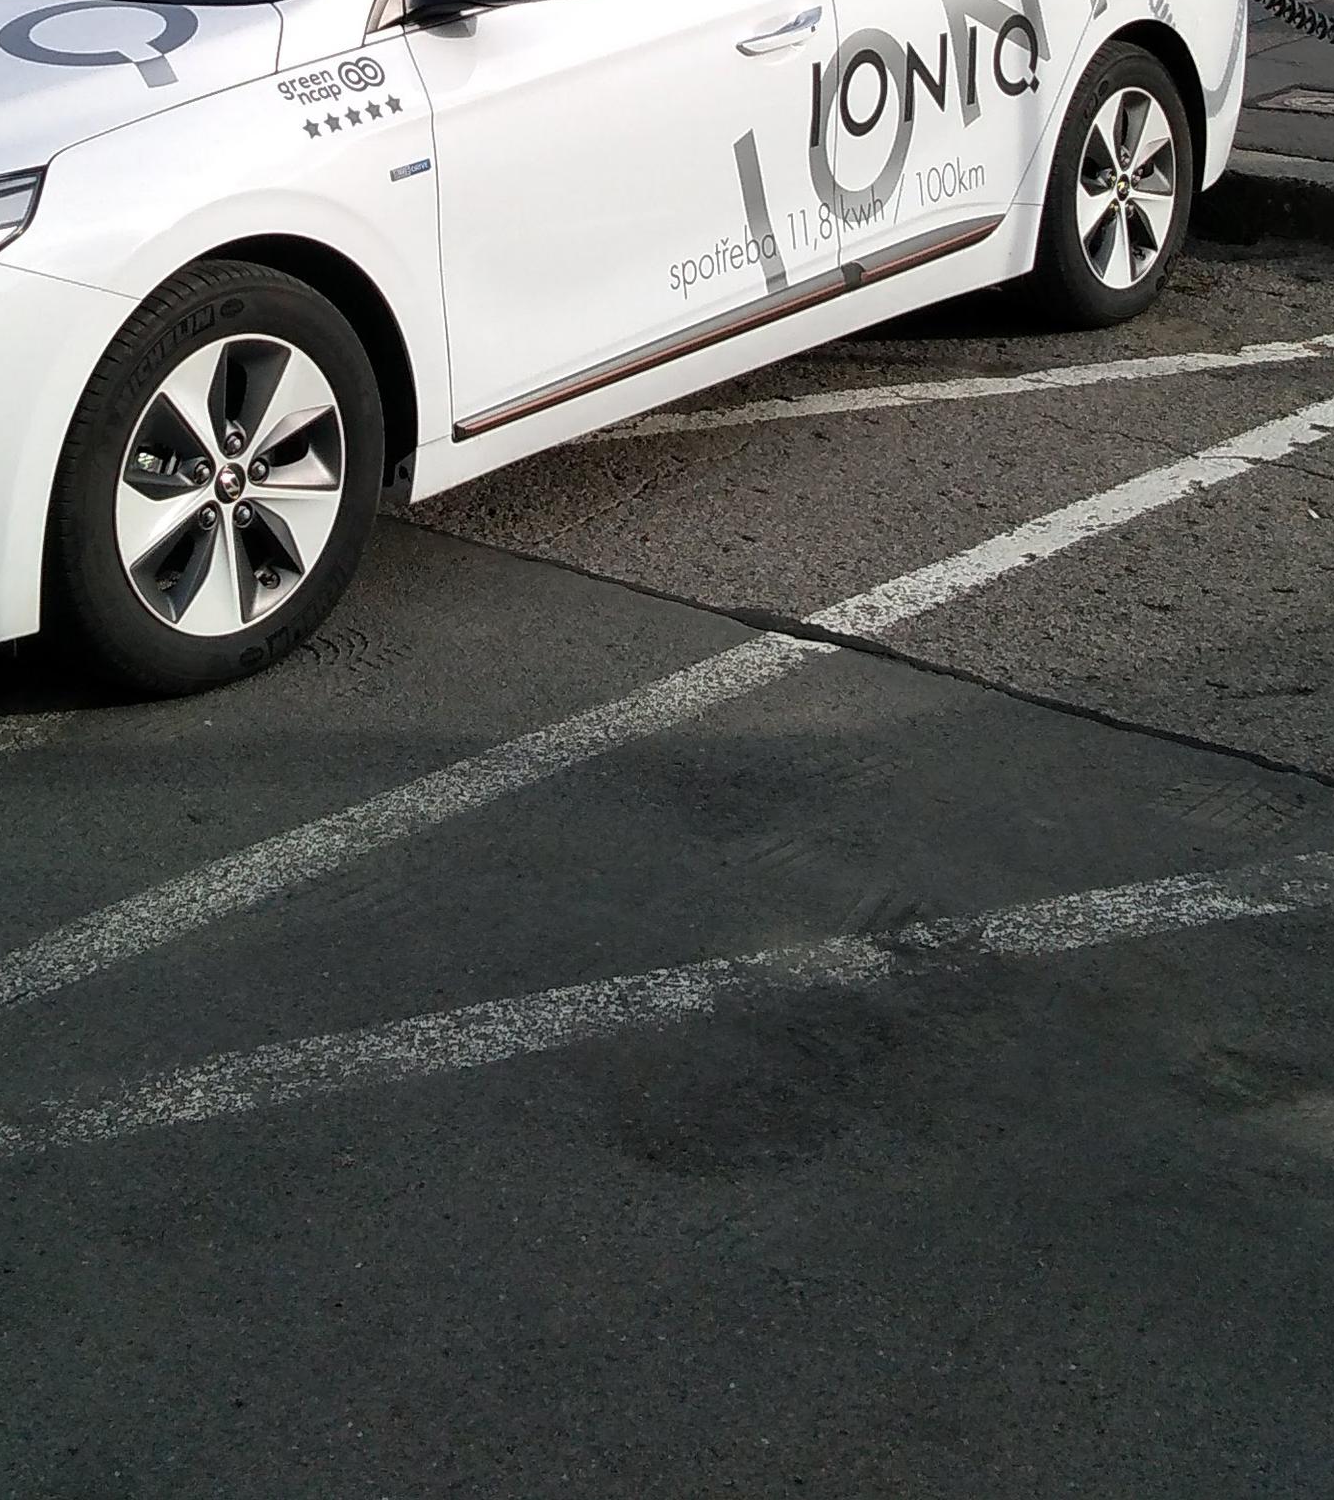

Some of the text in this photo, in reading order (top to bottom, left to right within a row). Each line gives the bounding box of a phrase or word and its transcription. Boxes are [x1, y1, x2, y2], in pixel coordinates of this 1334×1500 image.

[277, 69, 335, 100] green
[296, 82, 342, 106] ncap
[809, 14, 1041, 148] IONIQ
[669, 224, 777, 300] spotřeba
[787, 202, 832, 251] 11,8
[840, 184, 885, 234] kwh
[916, 156, 985, 207] 100km
